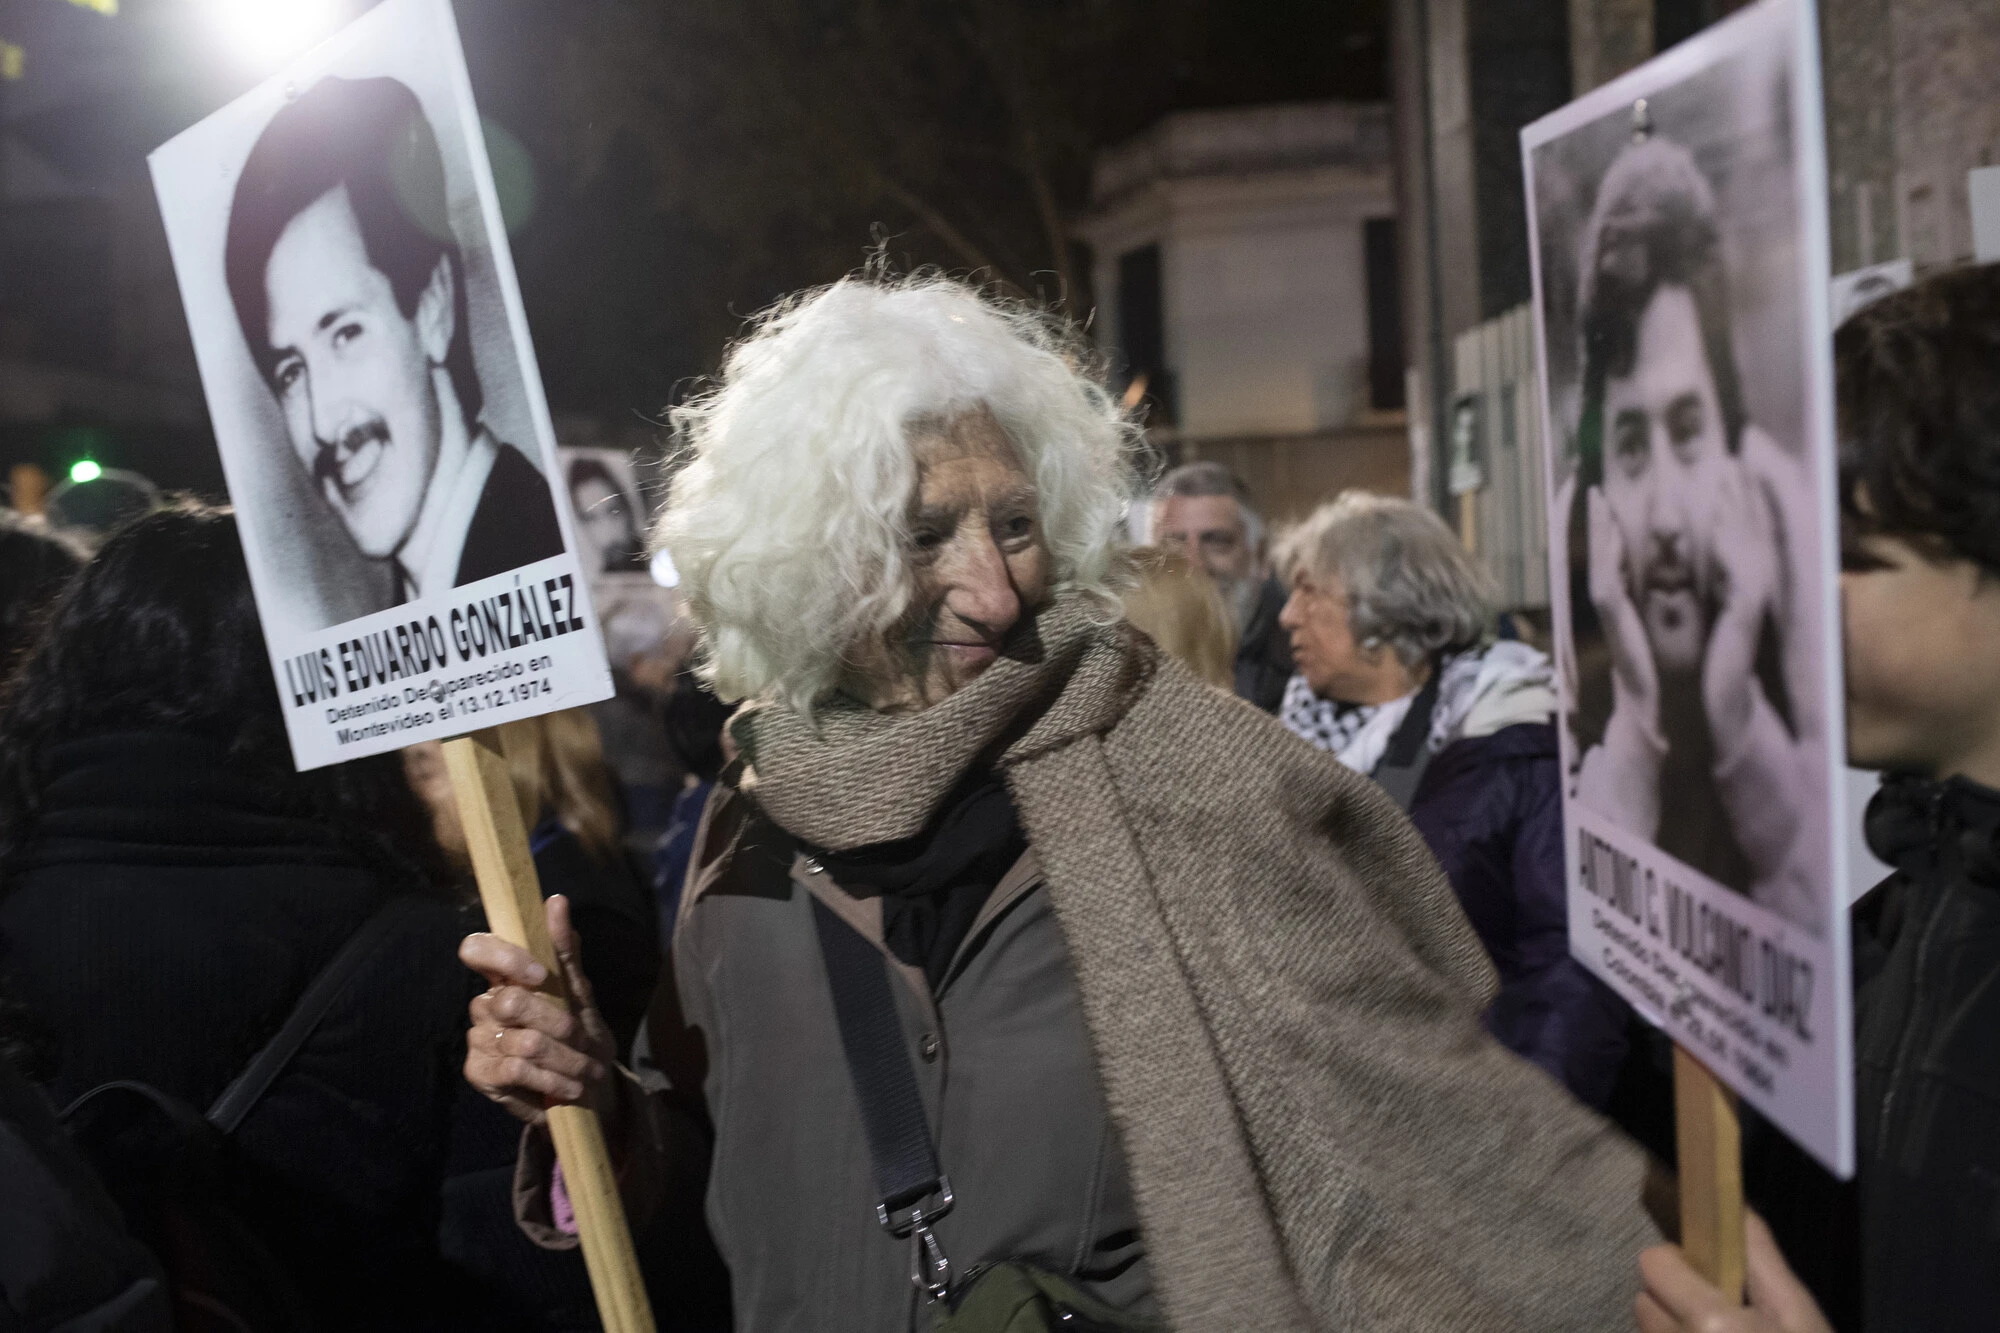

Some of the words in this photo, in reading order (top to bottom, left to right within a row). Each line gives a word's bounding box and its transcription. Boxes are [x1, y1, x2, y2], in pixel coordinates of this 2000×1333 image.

[284, 648, 340, 708] LUIS
[338, 615, 448, 693] EDUARDO
[450, 573, 585, 662] GONZÁLEZ
[325, 693, 401, 725] Detenido
[403, 661, 524, 702] Deparecido
[529, 655, 553, 671] en
[336, 712, 435, 745] Montevideo
[438, 701, 456, 719] el
[458, 677, 553, 716] 13.12.1974
